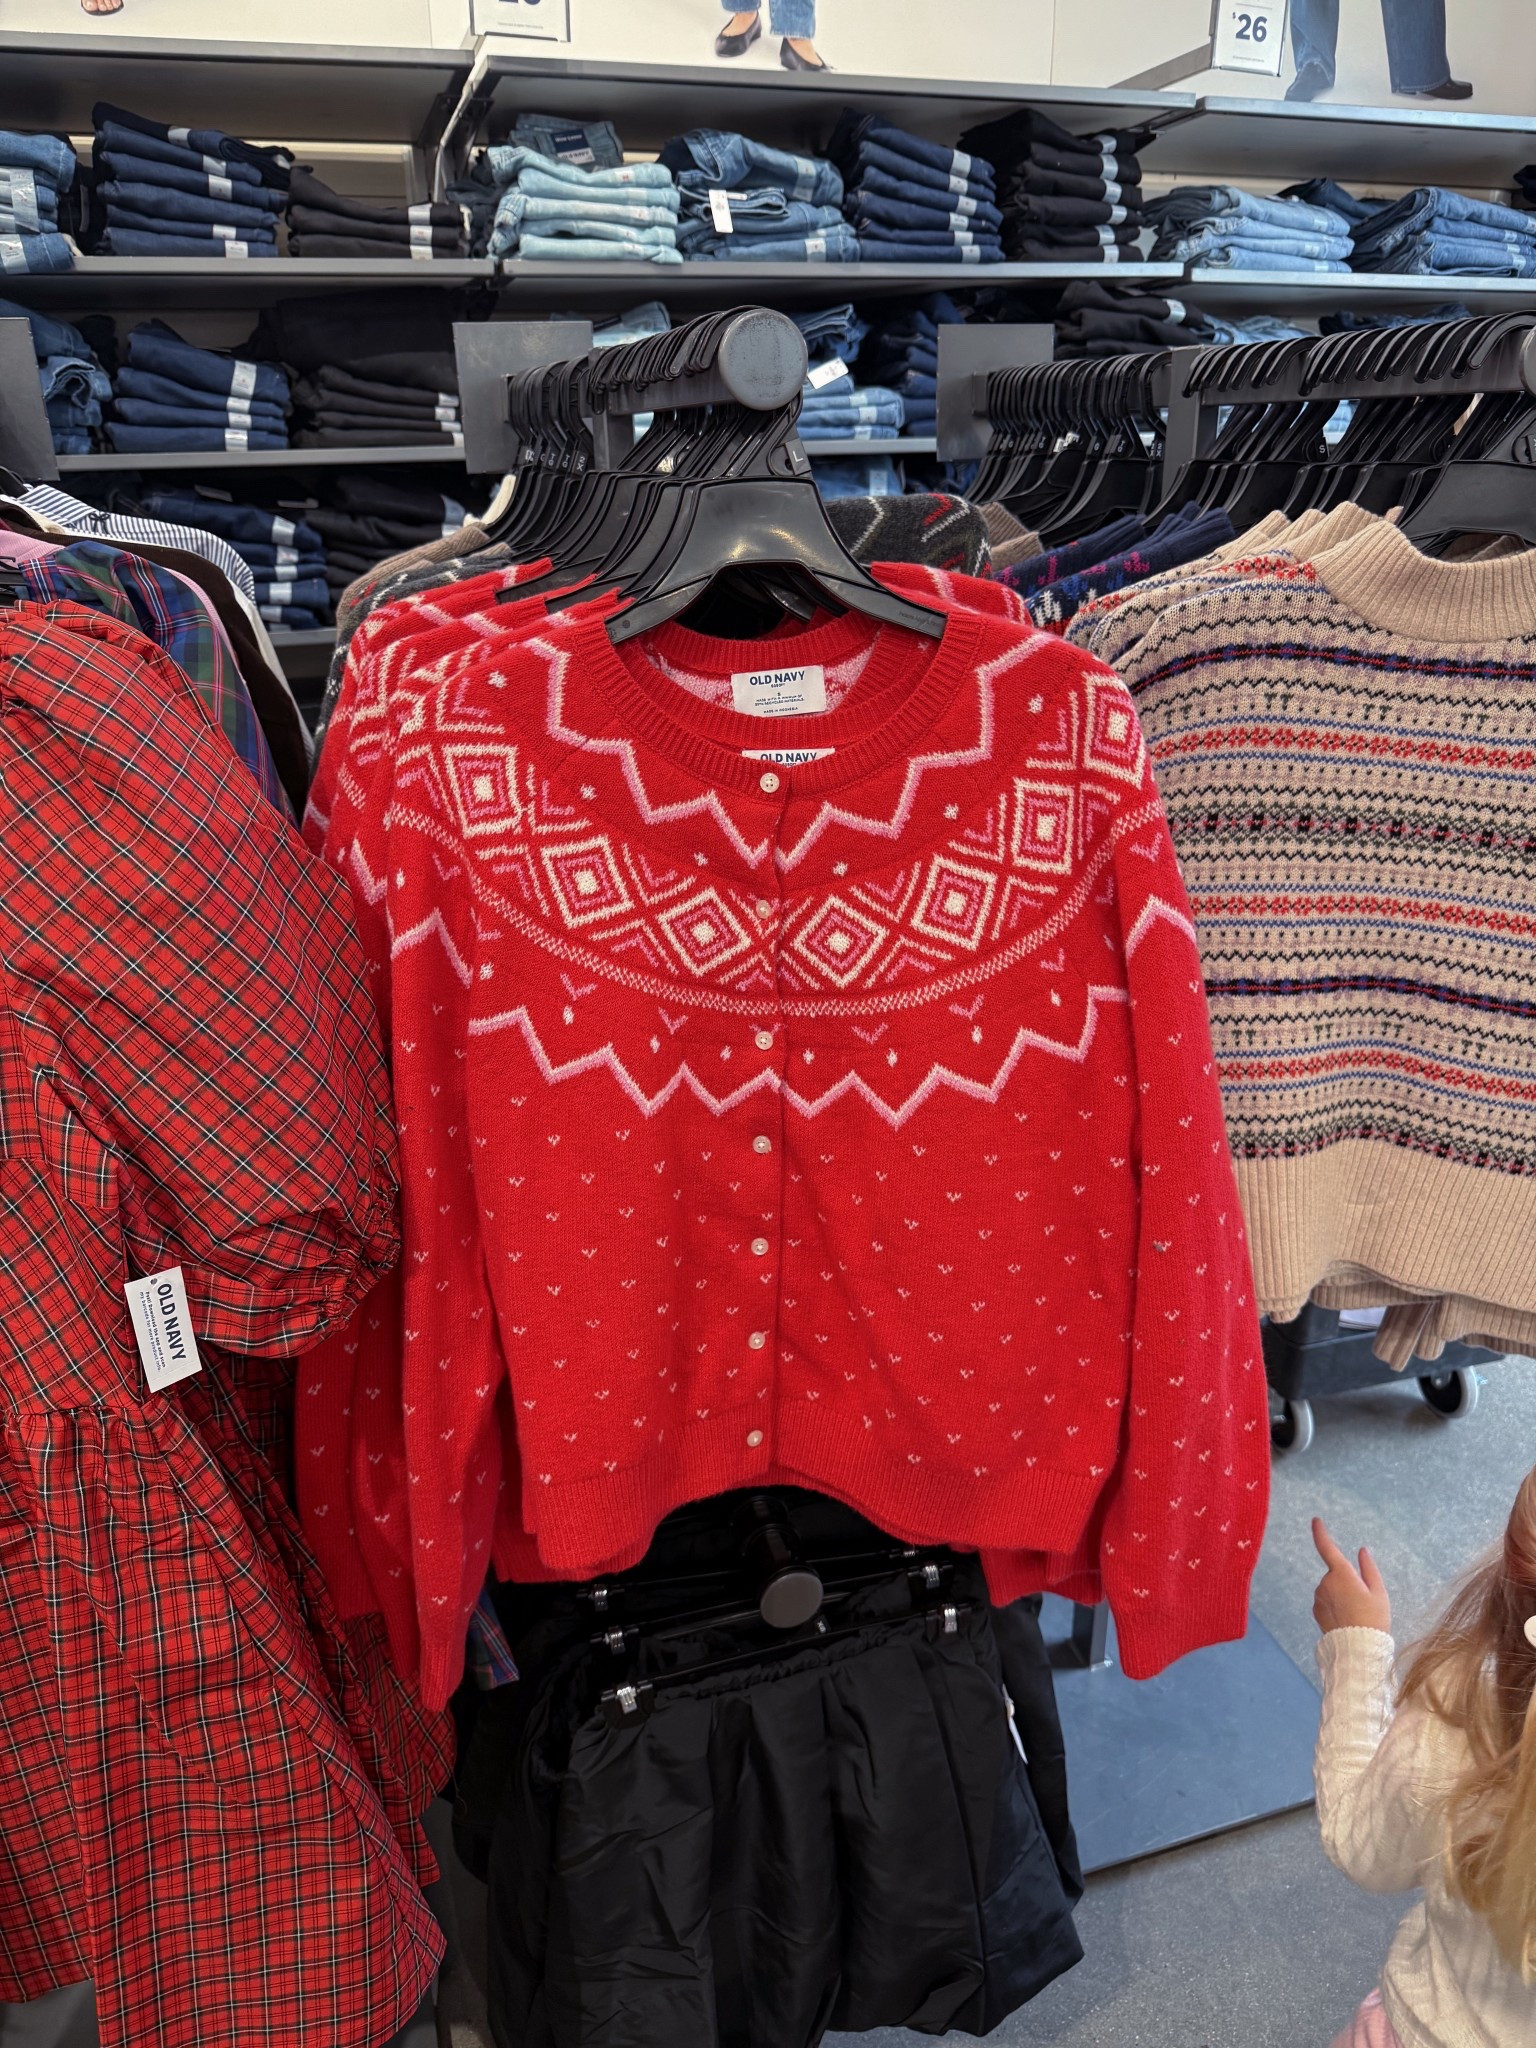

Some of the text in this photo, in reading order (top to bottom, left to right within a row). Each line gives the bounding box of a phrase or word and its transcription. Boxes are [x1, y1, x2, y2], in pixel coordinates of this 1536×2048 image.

[792, 450, 804, 463] L
[1156, 443, 1163, 457] 2X
[1318, 444, 1326, 454] S
[576, 456, 586, 472] 2X
[749, 671, 805, 686] OLD NAVY
[785, 752, 817, 763] NAVY
[148, 1304, 157, 1327] Download
[157, 1283, 187, 1361] OLD NAVY
[150, 1341, 158, 1360] product
